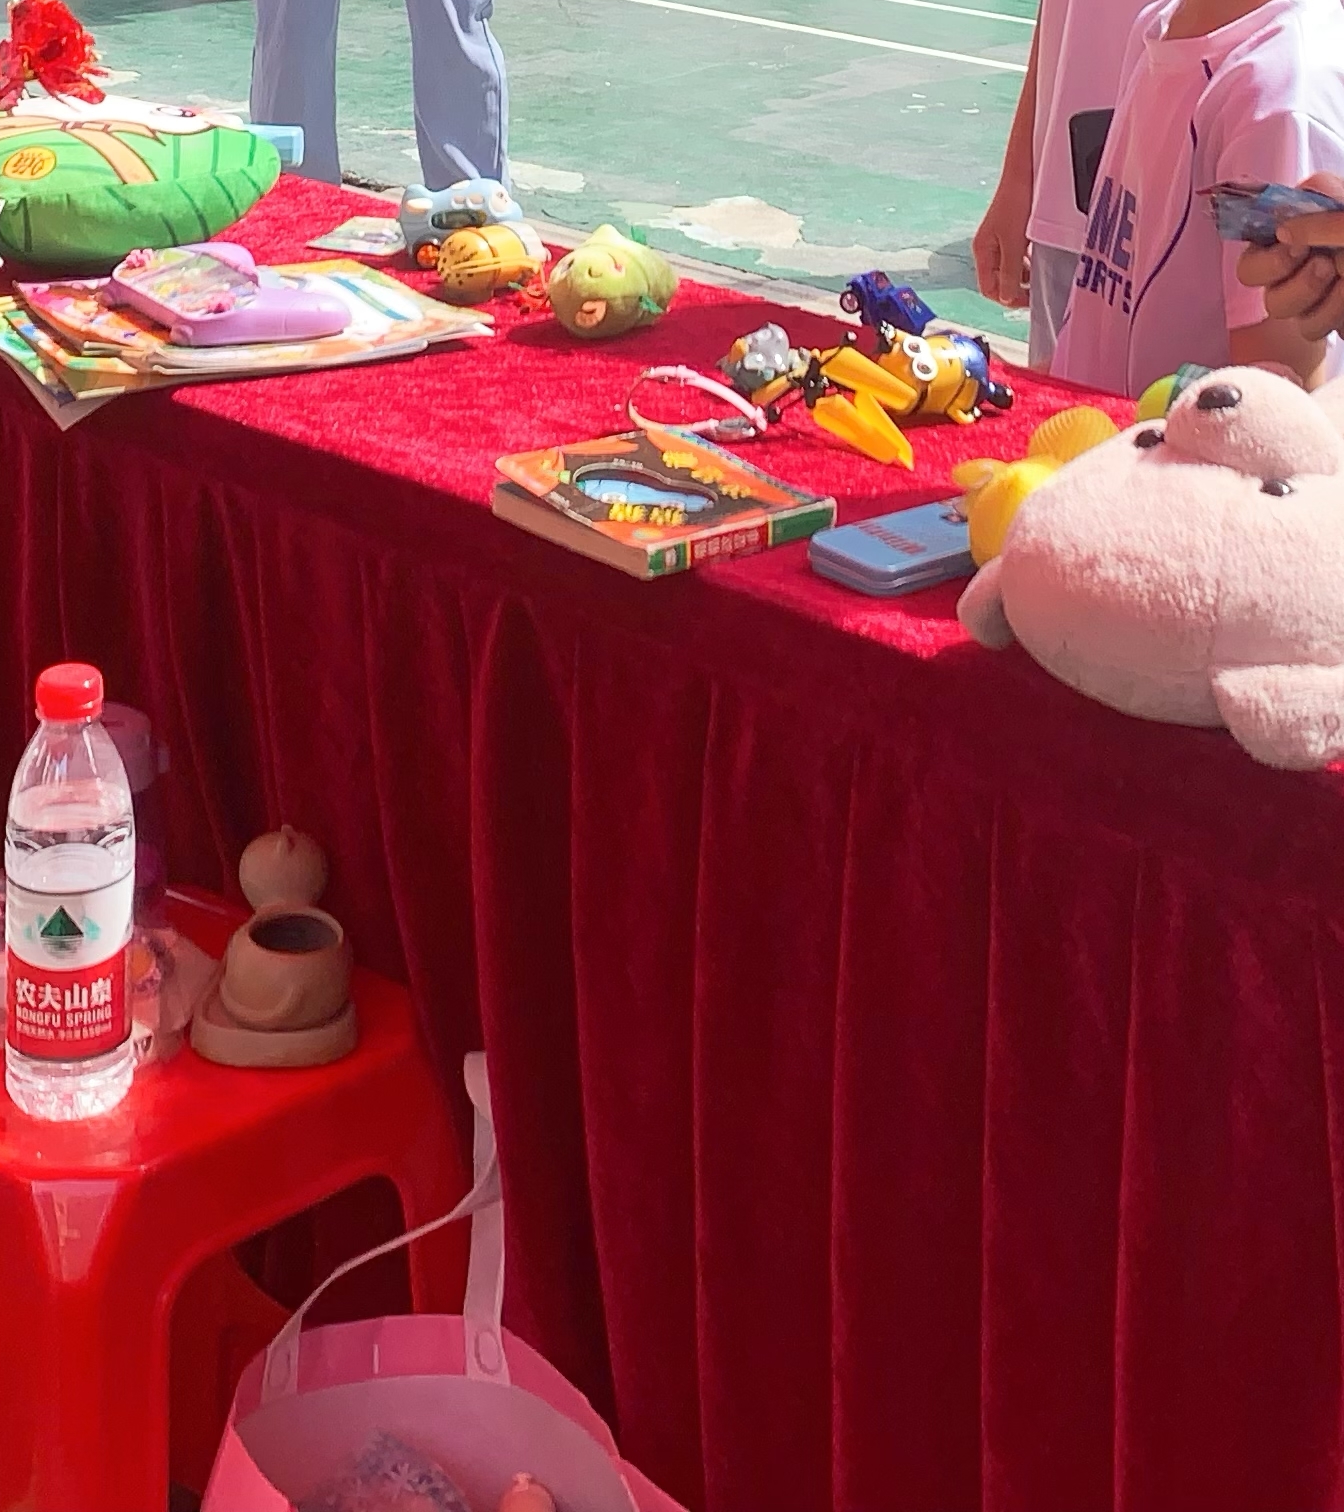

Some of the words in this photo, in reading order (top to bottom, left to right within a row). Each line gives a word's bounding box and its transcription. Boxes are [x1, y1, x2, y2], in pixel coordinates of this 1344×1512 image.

[16, 977, 112, 1011] 农夫山泉
[16, 1003, 61, 1028] NONGFU
[66, 1003, 112, 1028] SPRING
